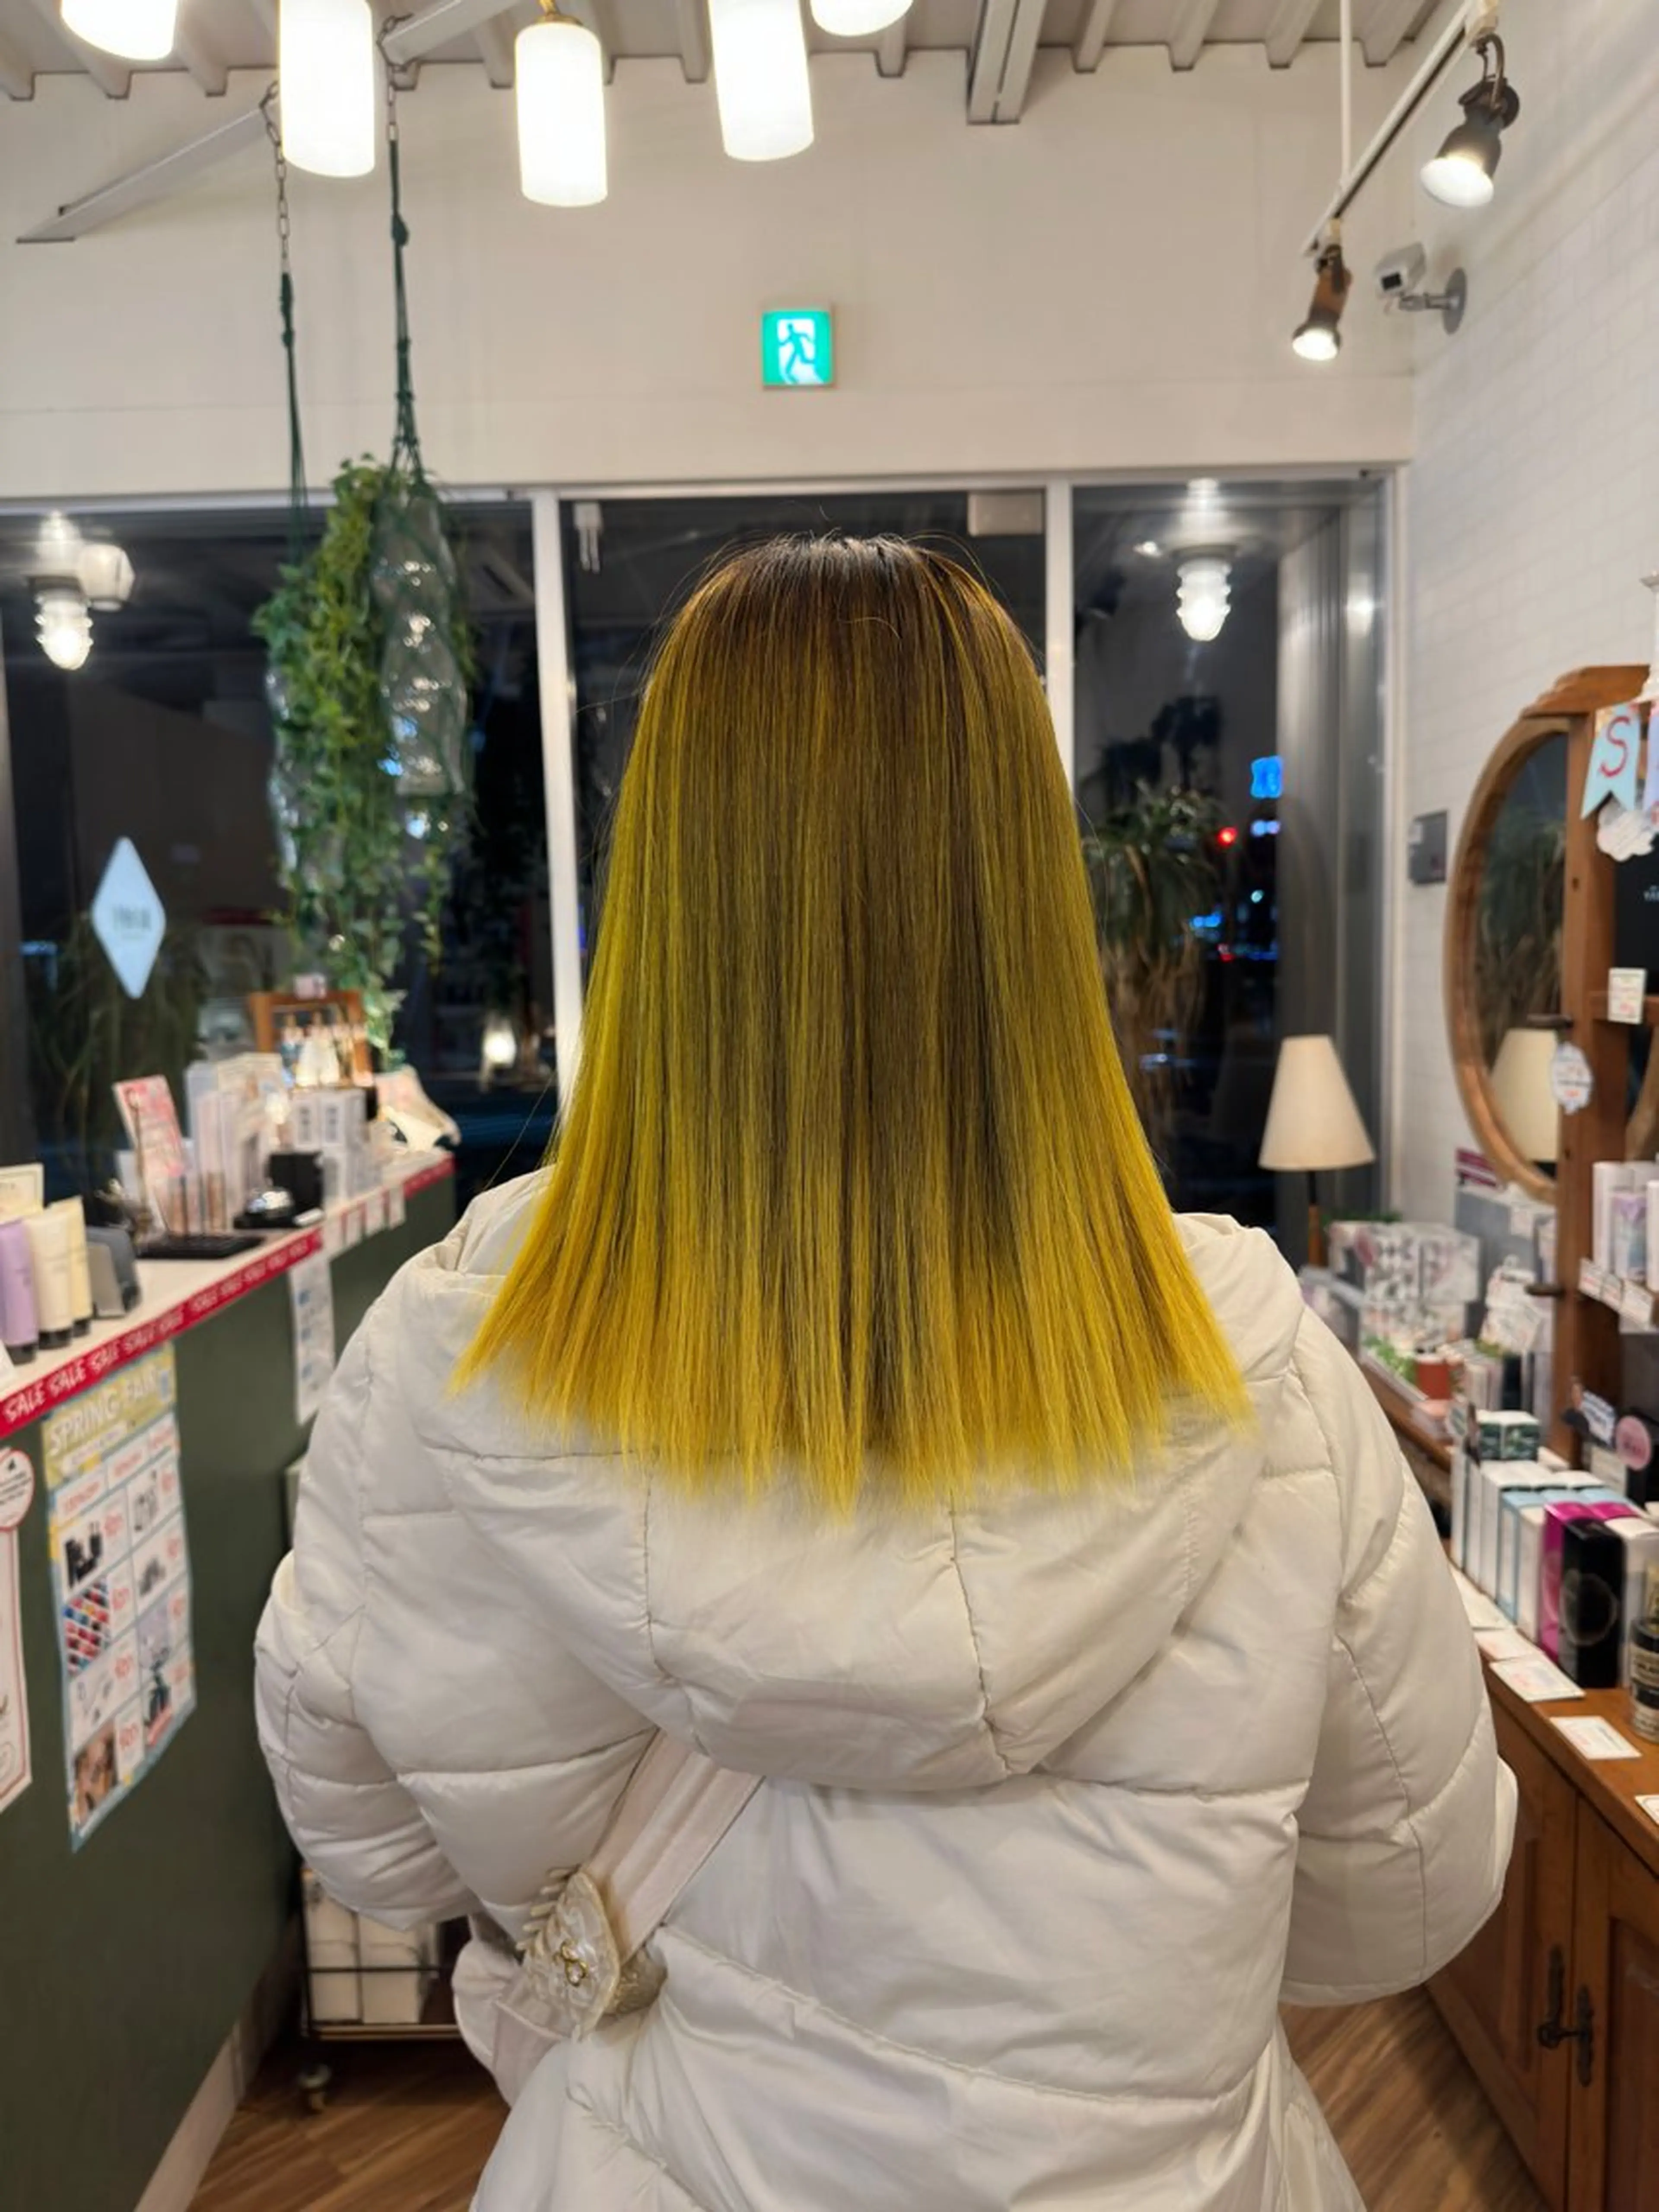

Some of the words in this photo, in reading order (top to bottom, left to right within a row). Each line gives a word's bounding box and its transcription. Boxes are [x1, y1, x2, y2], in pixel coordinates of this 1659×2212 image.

[1599, 716, 1630, 777] S
[3, 1383, 45, 1424] SALE
[48, 1358, 86, 1397] SALE
[87, 1339, 120, 1374] SALE
[50, 1389, 121, 1456] SPRING
[125, 1362, 159, 1401] FAIR
